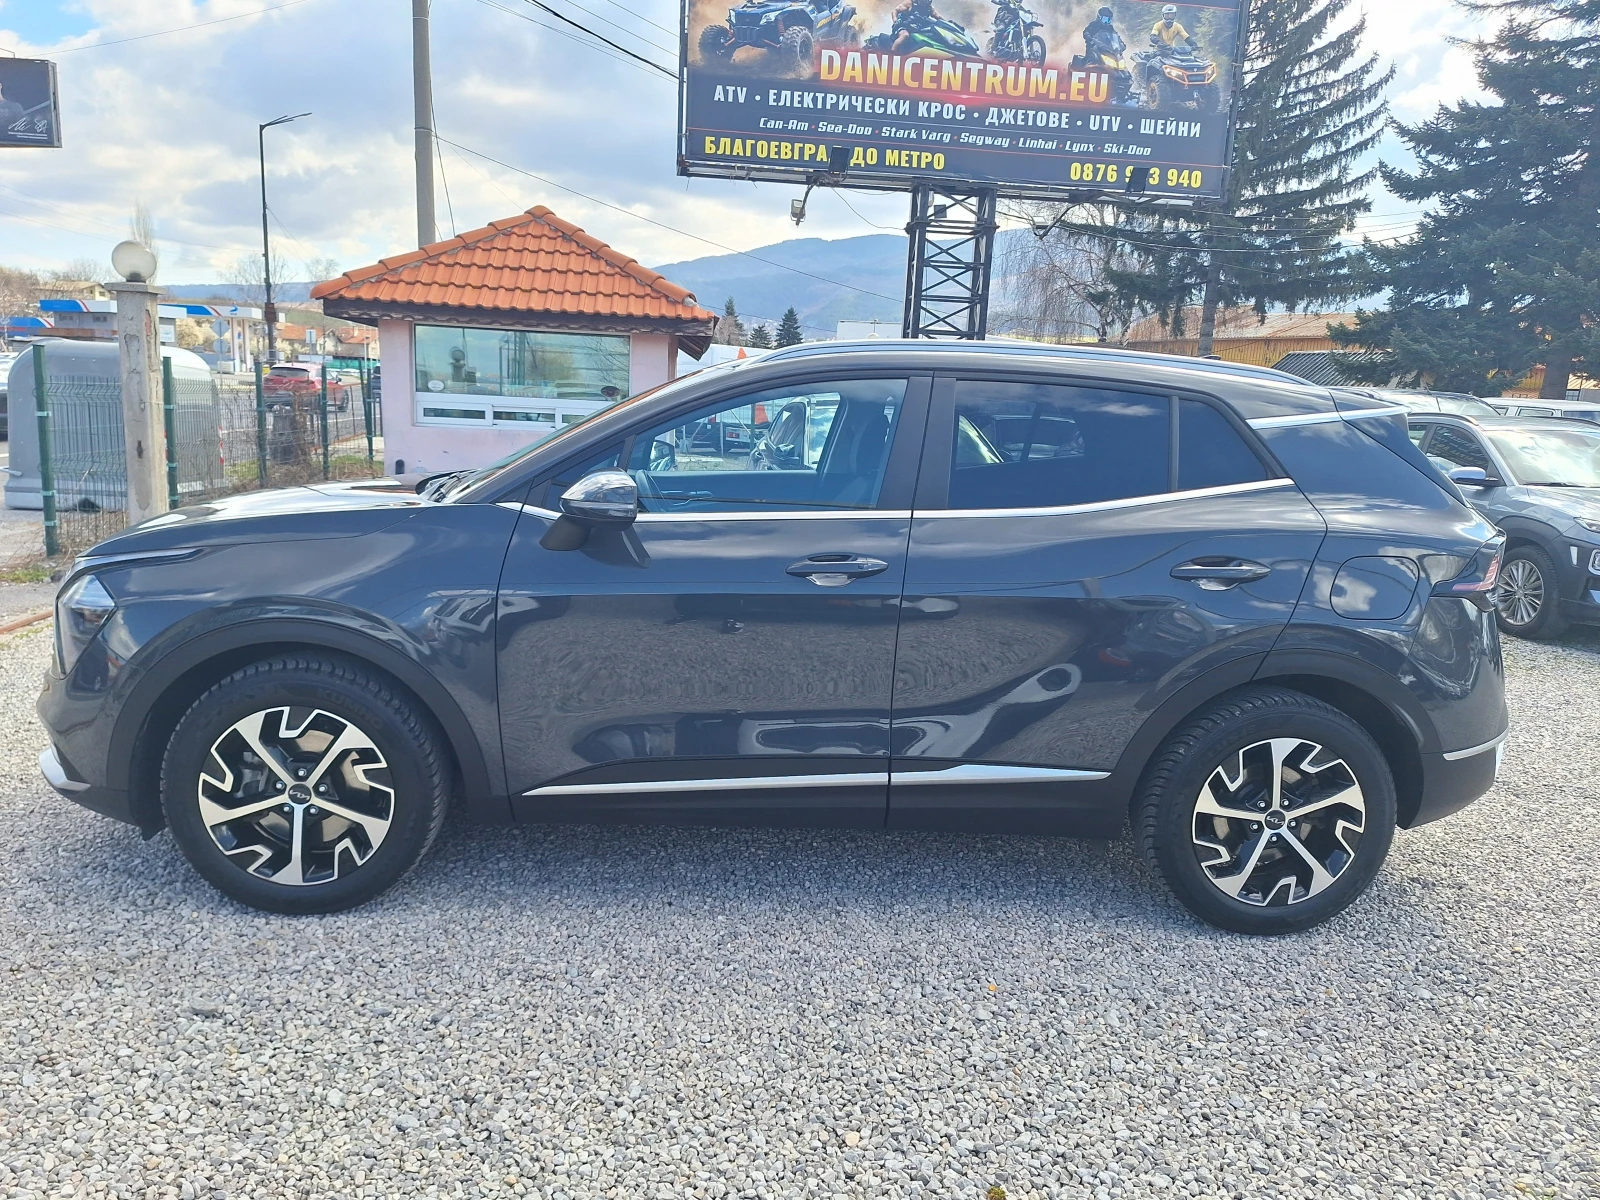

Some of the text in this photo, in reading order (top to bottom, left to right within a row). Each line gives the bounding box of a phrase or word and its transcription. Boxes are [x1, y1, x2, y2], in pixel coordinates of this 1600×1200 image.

[820, 49, 1109, 103] DANICENTRUM.EU
[714, 84, 1201, 138] ATV ЕЛЕКТРИЧЕСКИ КРОС ДЖЕТОВЕ UTV ШЕЙНИ
[704, 136, 945, 170] БЛАГОЕВГРА ДО МЕТРО
[759, 117, 1152, 157] Can-Am Sea-Doo Stark Varg Segway Linhai Lynx Ski-Doo
[1070, 162, 1202, 188] 0876 93 940
